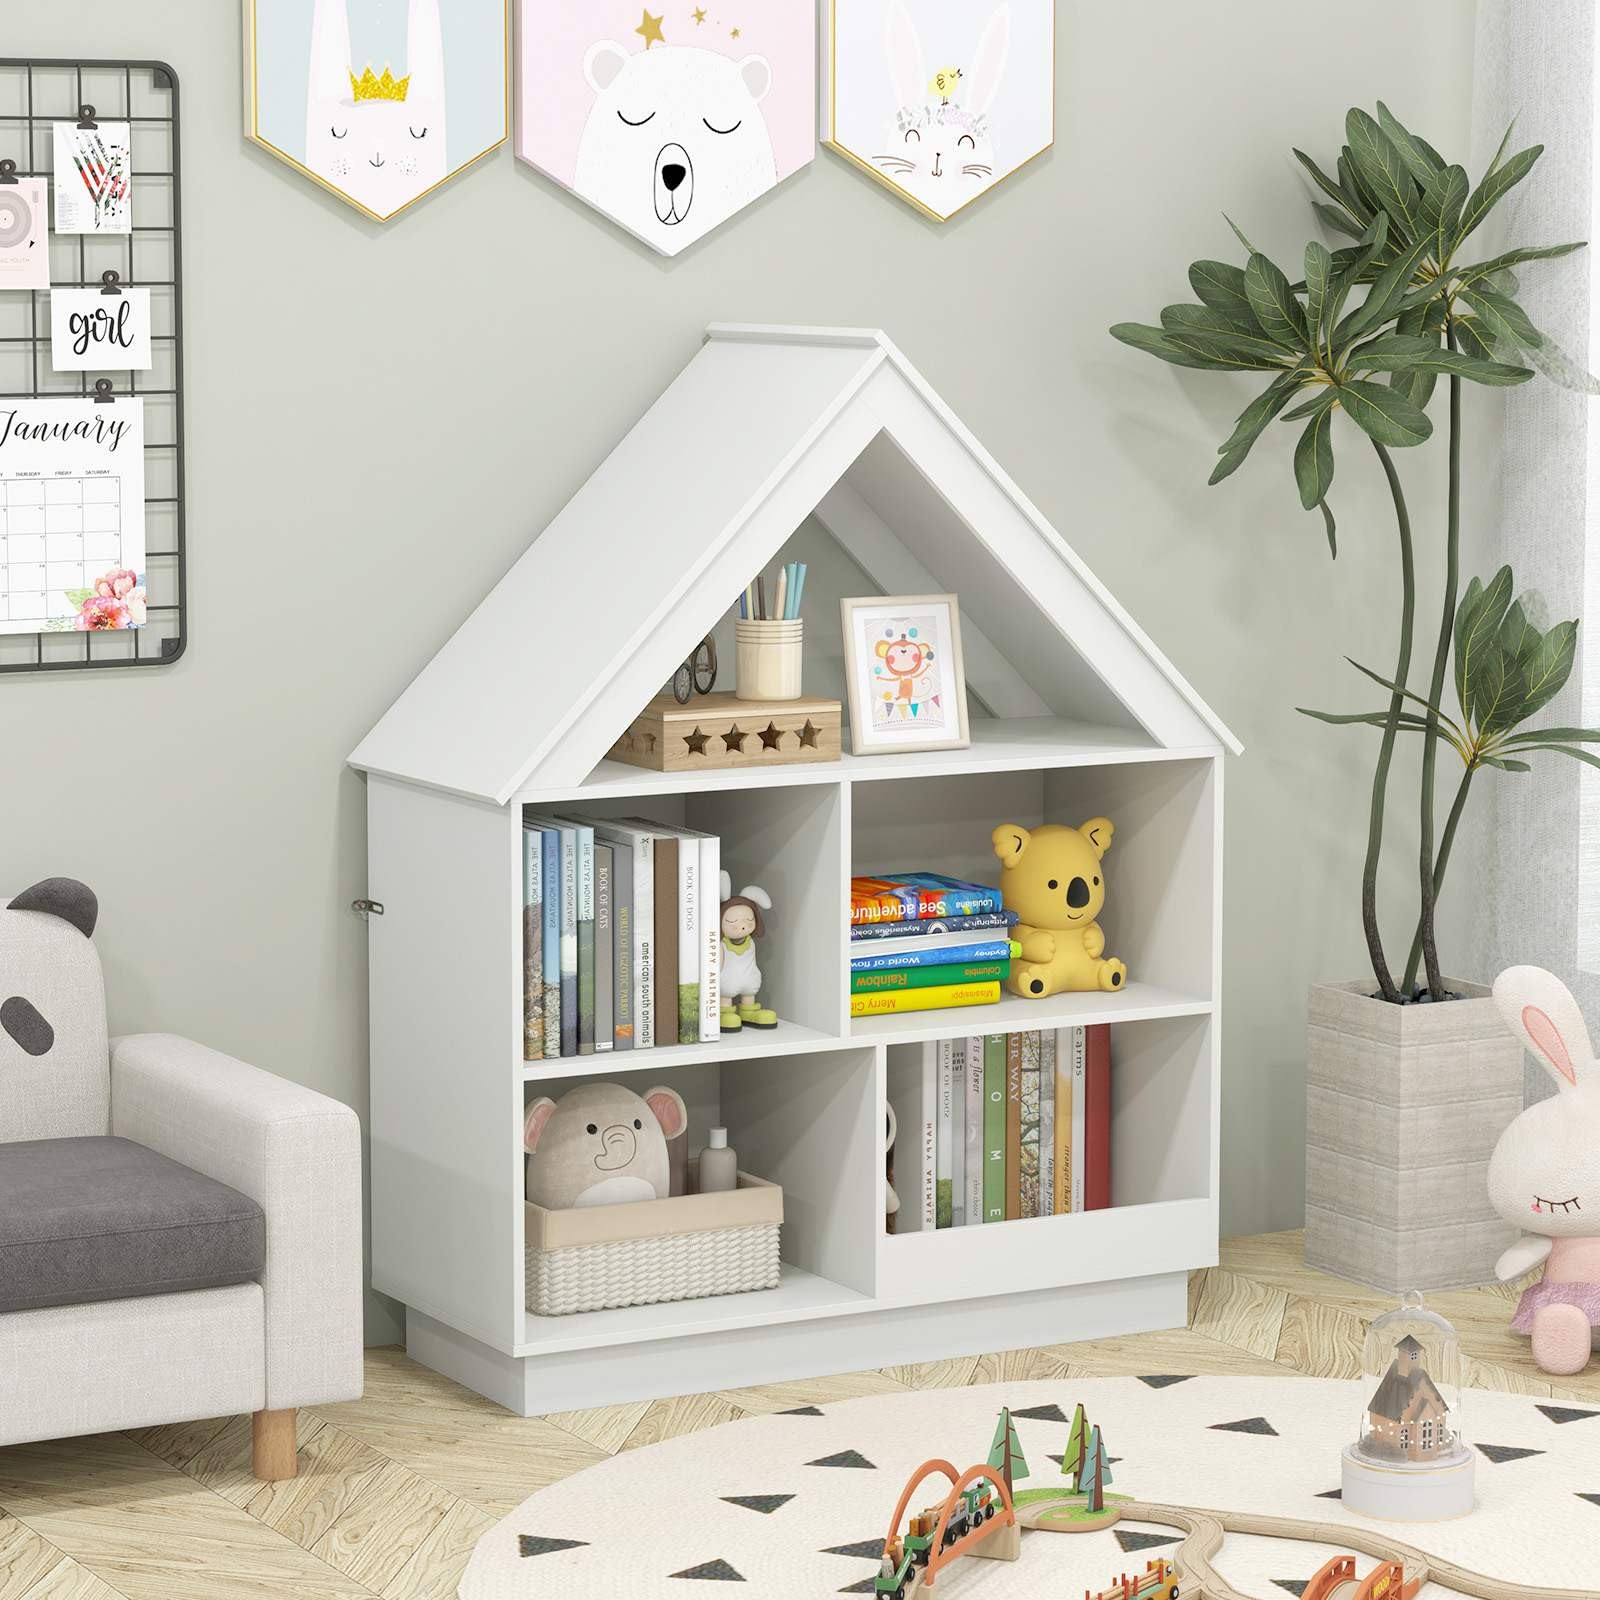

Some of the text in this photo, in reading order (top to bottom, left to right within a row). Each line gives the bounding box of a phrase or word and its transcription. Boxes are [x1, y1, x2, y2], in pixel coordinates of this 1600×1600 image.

[69, 300, 134, 355] girl
[599, 867, 608, 929] BOOK OF CATS
[686, 866, 694, 931] BOOK OF DOGS
[919, 901, 947, 915] Sea
[956, 898, 993, 909] Louisiana
[620, 906, 628, 936] WORLD
[620, 938, 628, 949] OF
[974, 949, 1007, 958] Sydney
[708, 931, 716, 1018] HAPPY ANIMALS
[888, 957, 921, 966] World
[642, 942, 650, 1044] american south animals
[856, 974, 907, 988] Rainbow
[868, 998, 896, 1009] Merry
[1075, 1041, 1083, 1077] arms
[970, 1065, 982, 1094] flower
[1010, 1067, 1019, 1102] WAY
